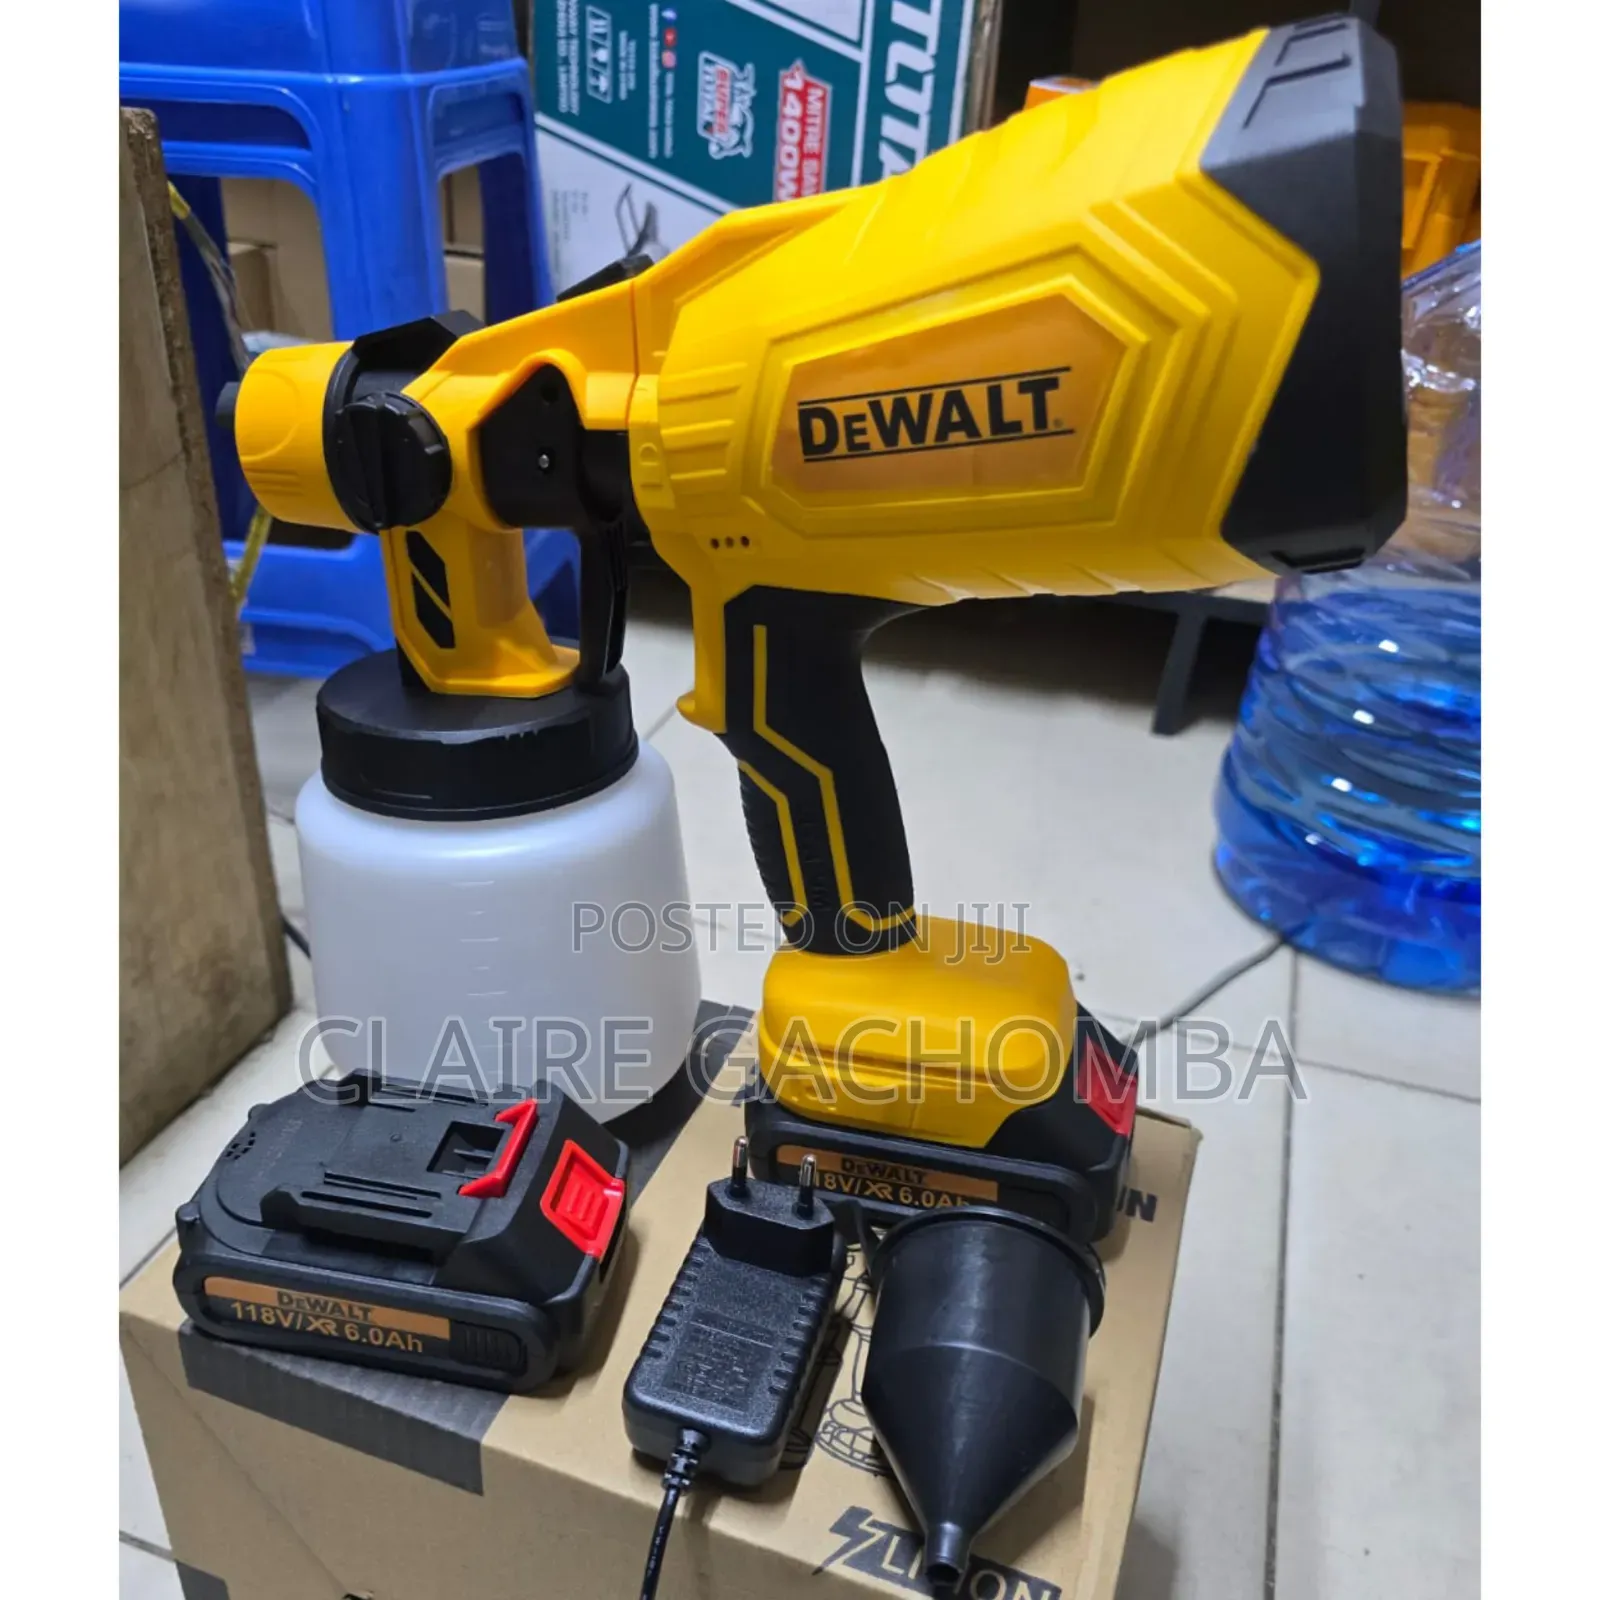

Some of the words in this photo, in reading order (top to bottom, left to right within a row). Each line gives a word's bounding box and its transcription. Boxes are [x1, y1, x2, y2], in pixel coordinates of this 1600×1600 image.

[777, 71, 805, 202] 1400W
[804, 86, 825, 153] MITRE
[797, 375, 1060, 457] DEWALT
[276, 1290, 374, 1322] DEWALT
[344, 1322, 423, 1354] 6.0Ah
